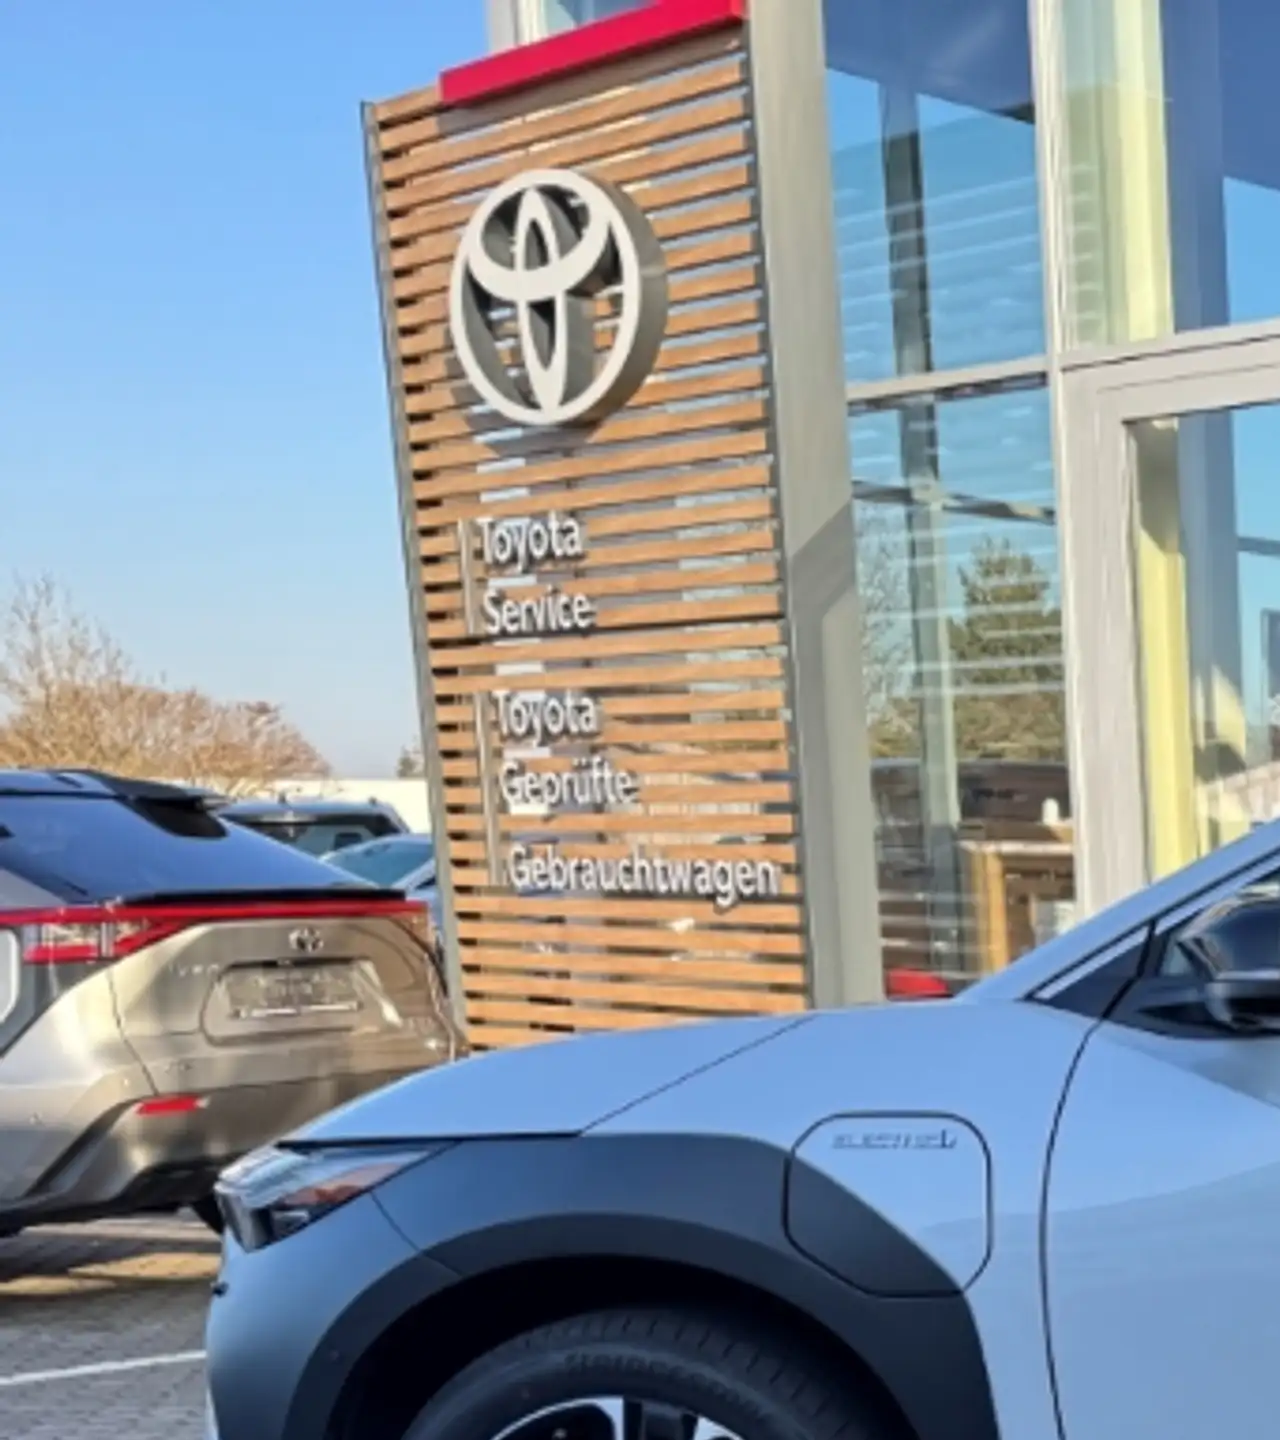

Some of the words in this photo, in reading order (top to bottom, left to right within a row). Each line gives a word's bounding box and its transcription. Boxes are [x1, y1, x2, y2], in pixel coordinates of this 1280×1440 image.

[477, 511, 584, 571] Toyota
[483, 586, 596, 633] Service
[492, 689, 599, 745] Toyota
[501, 757, 639, 808] Geprüfte
[508, 843, 778, 906] Gebrauchtwagen
